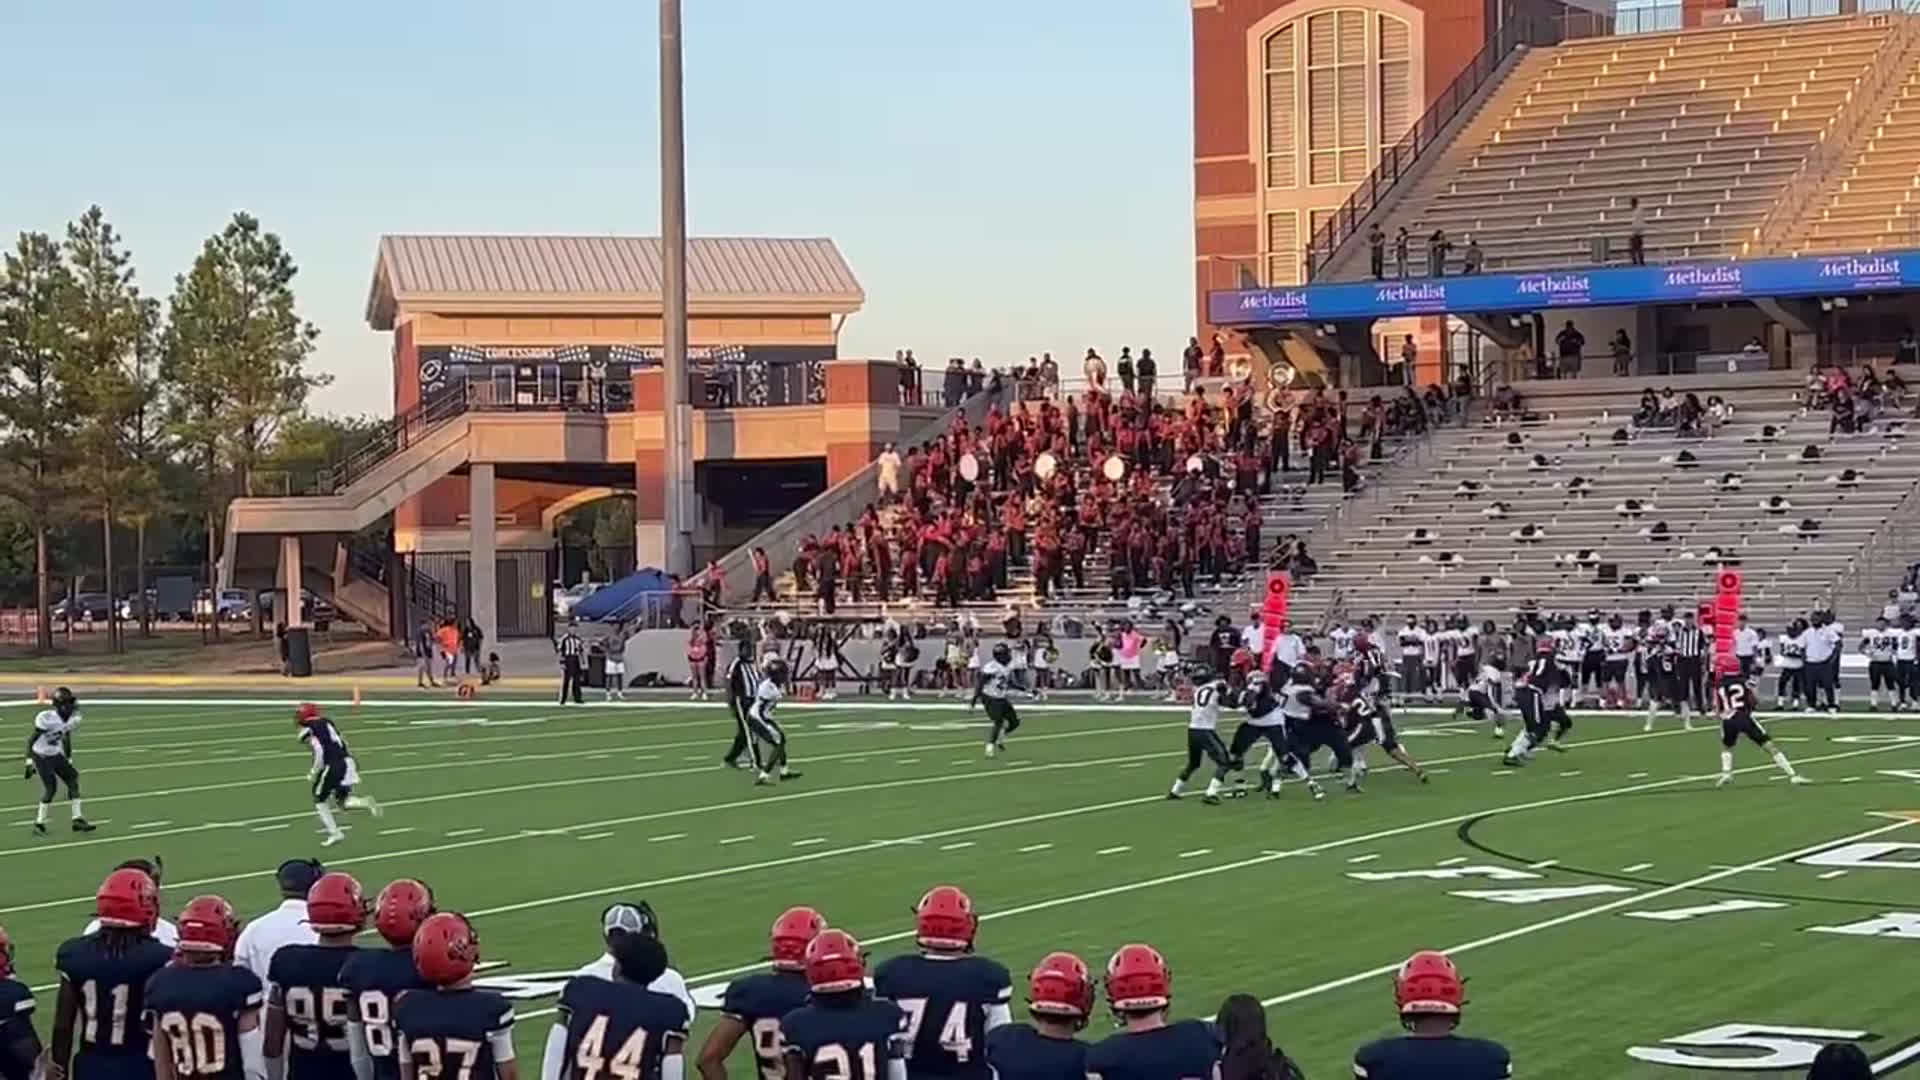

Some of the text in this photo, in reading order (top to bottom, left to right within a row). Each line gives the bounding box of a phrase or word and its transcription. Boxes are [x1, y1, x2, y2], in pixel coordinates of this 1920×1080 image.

[1718, 683, 1745, 711] 12
[82, 978, 130, 1046] 11
[161, 1011, 226, 1076] 80
[897, 998, 973, 1063] 74
[576, 1014, 648, 1080] 44
